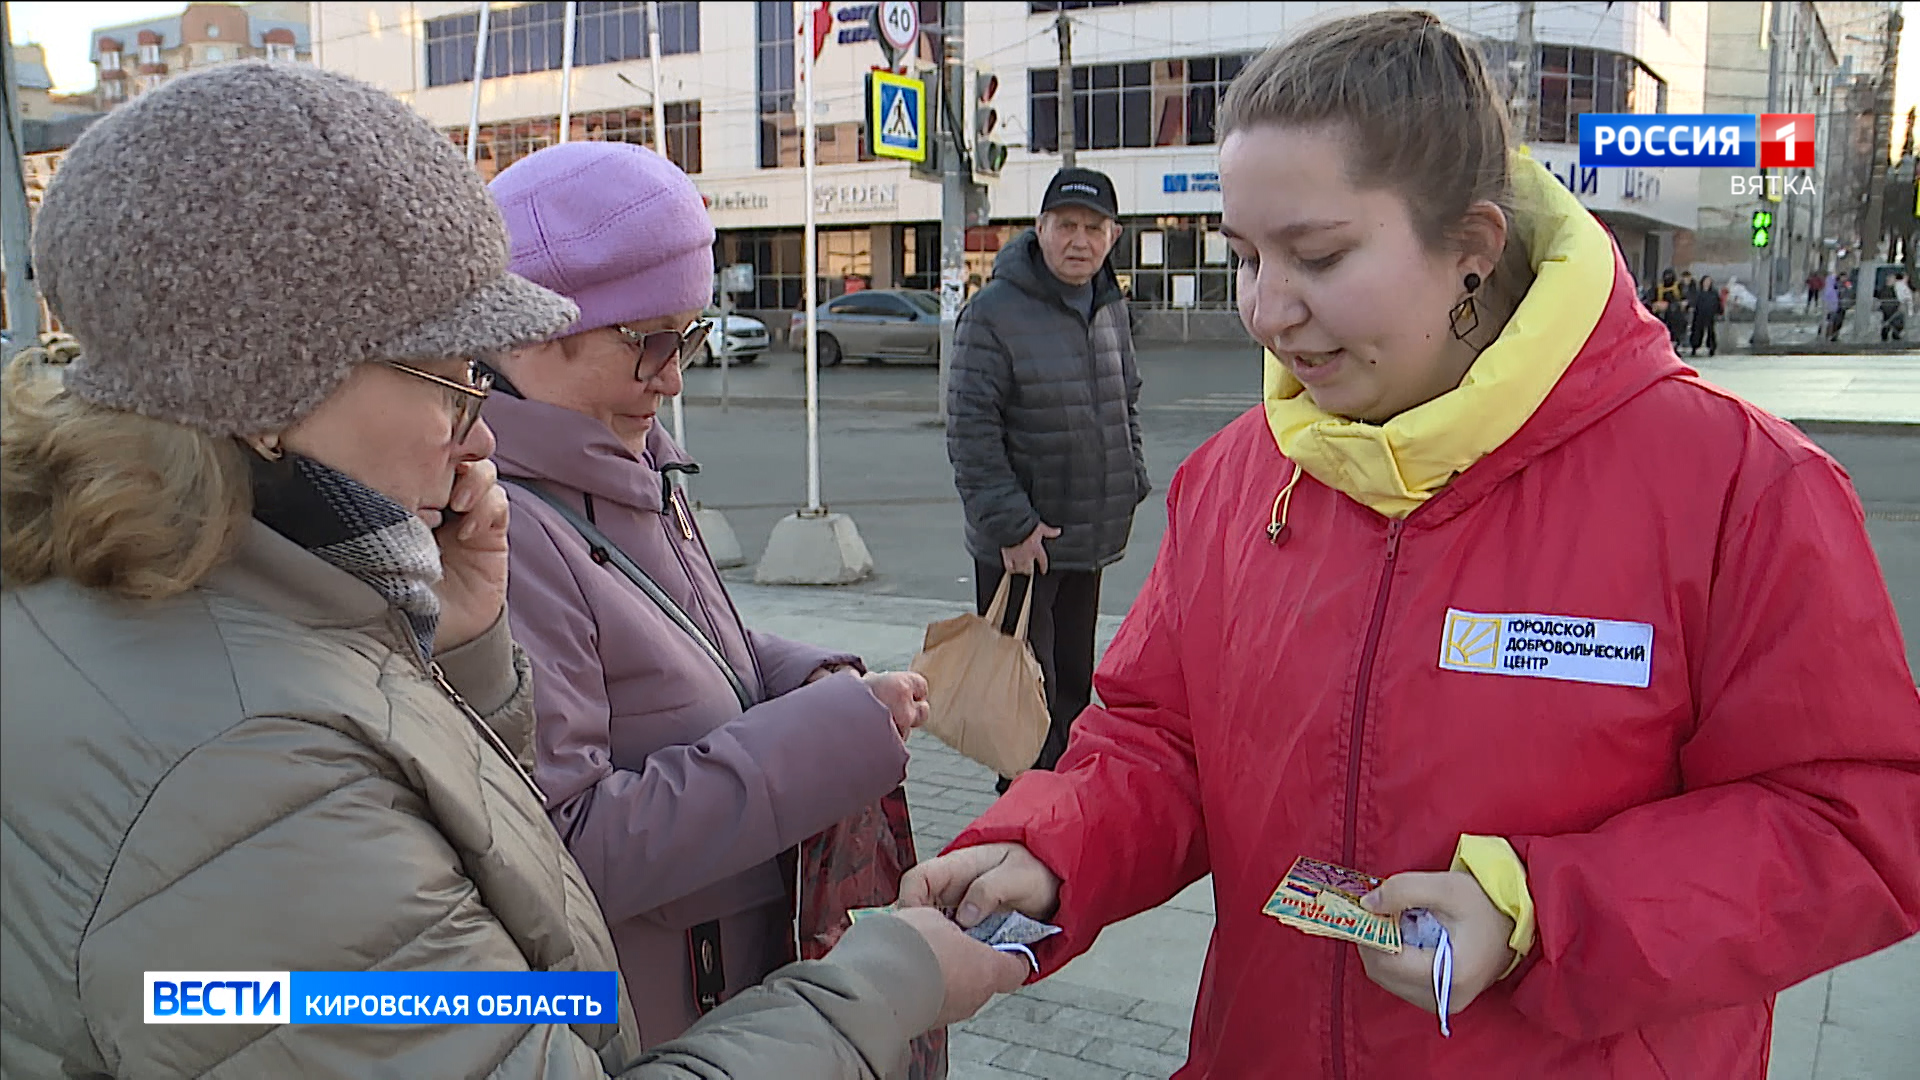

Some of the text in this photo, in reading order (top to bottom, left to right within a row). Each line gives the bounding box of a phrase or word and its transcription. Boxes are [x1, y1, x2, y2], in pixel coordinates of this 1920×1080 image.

[888, 6, 911, 33] 40
[1507, 619, 1596, 638] ГОРОДСКОЙ
[1505, 637, 1646, 662] ДОБРОВОЛЬЧЕСКИЙ
[1503, 655, 1549, 671] ЦЕНТР
